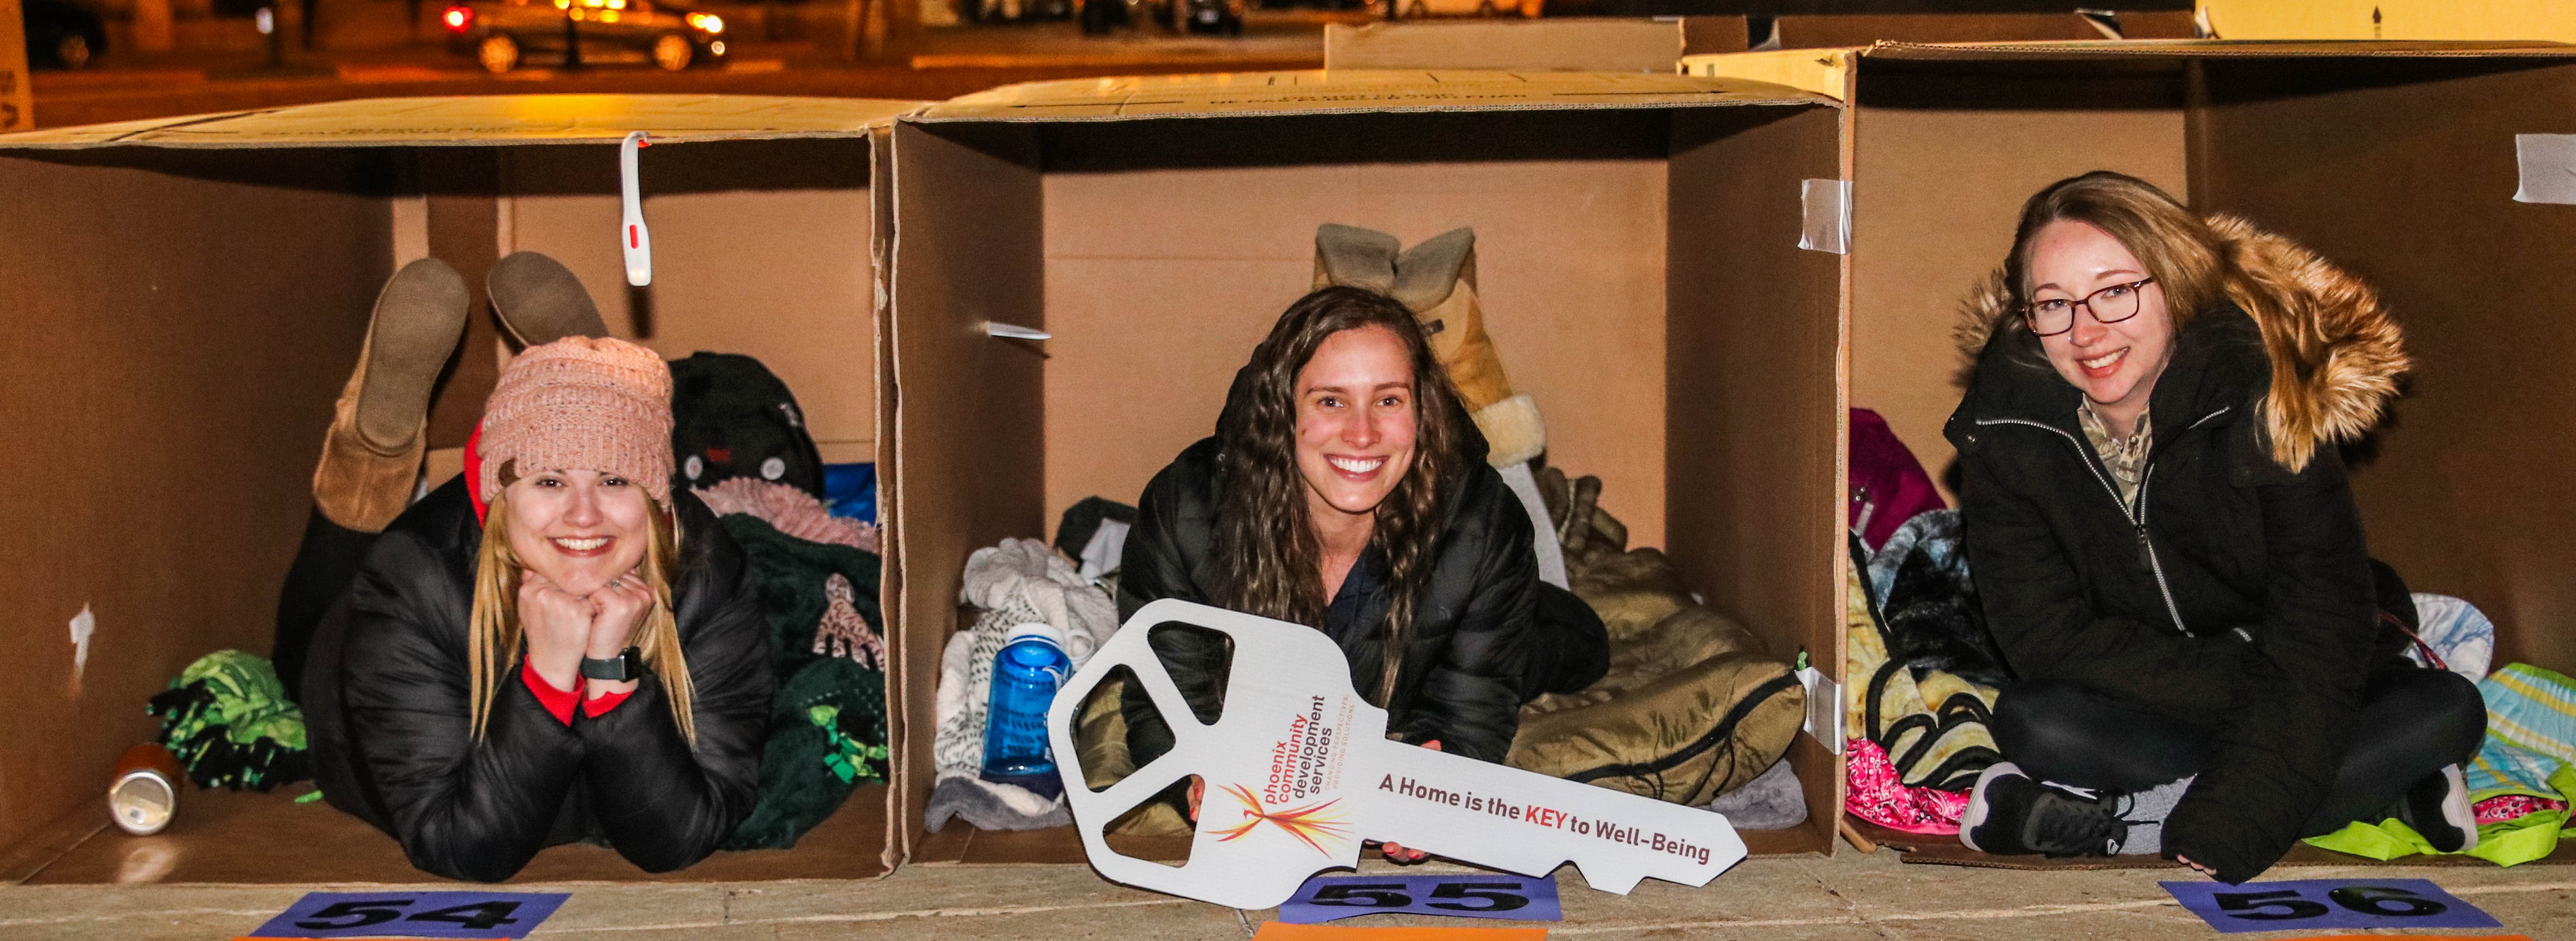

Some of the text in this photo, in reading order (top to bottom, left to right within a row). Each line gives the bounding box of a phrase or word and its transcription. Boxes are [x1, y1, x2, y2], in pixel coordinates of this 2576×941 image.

[1264, 740, 1287, 805] phoenix
[1279, 713, 1308, 803] community
[1293, 695, 1325, 799] development
[1310, 727, 1332, 795] services
[1324, 753, 1336, 791] CHANGING
[1333, 747, 1346, 789] PROVIDING
[1379, 773, 1710, 865] A Home is the KEY to Well-Being
[295, 899, 523, 929] 54
[1308, 882, 1530, 911] 55
[2212, 887, 2448, 920] 56
